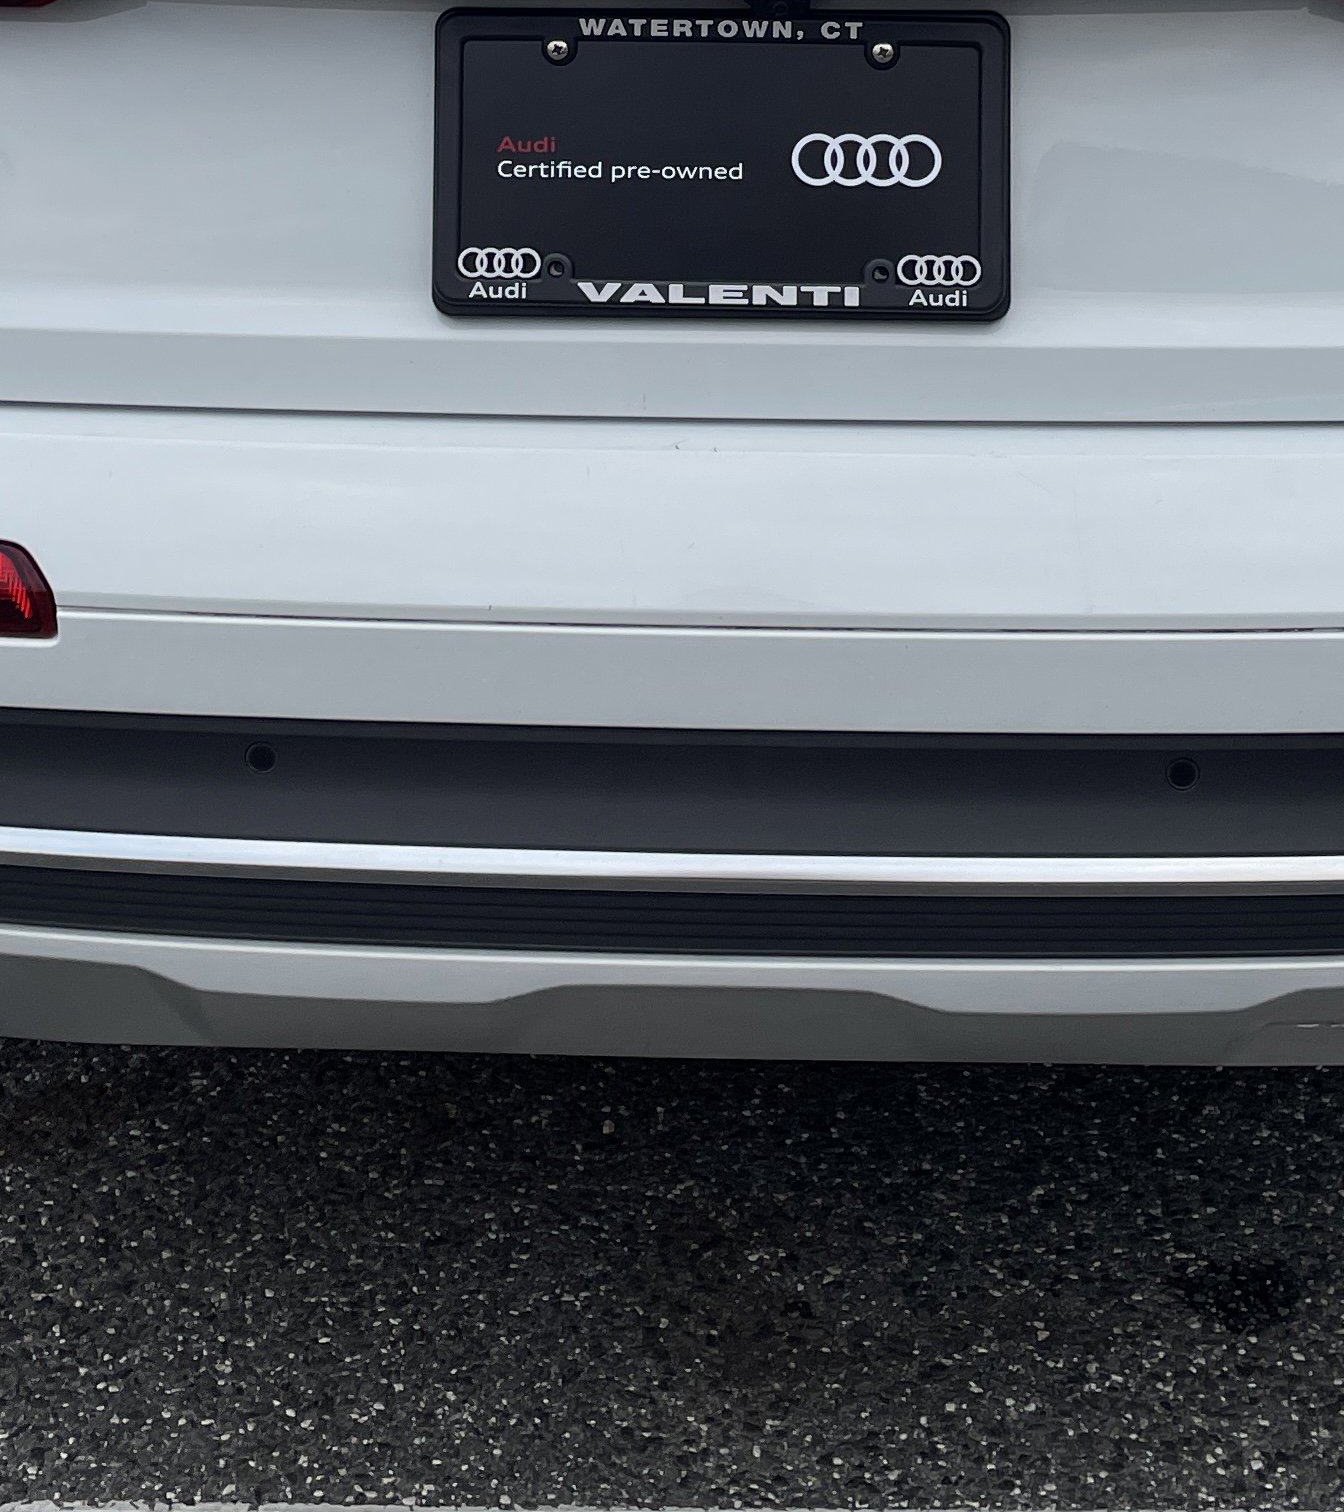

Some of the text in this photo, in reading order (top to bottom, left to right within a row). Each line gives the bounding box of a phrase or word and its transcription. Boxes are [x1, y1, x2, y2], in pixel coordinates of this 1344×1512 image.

[578, 18, 864, 41] WATERTOWN, CT
[497, 136, 557, 154] Audi
[497, 160, 744, 183] Certified pre-owned
[468, 280, 528, 300] Audi
[576, 281, 860, 307] VALENTI
[908, 288, 969, 308] Audi
